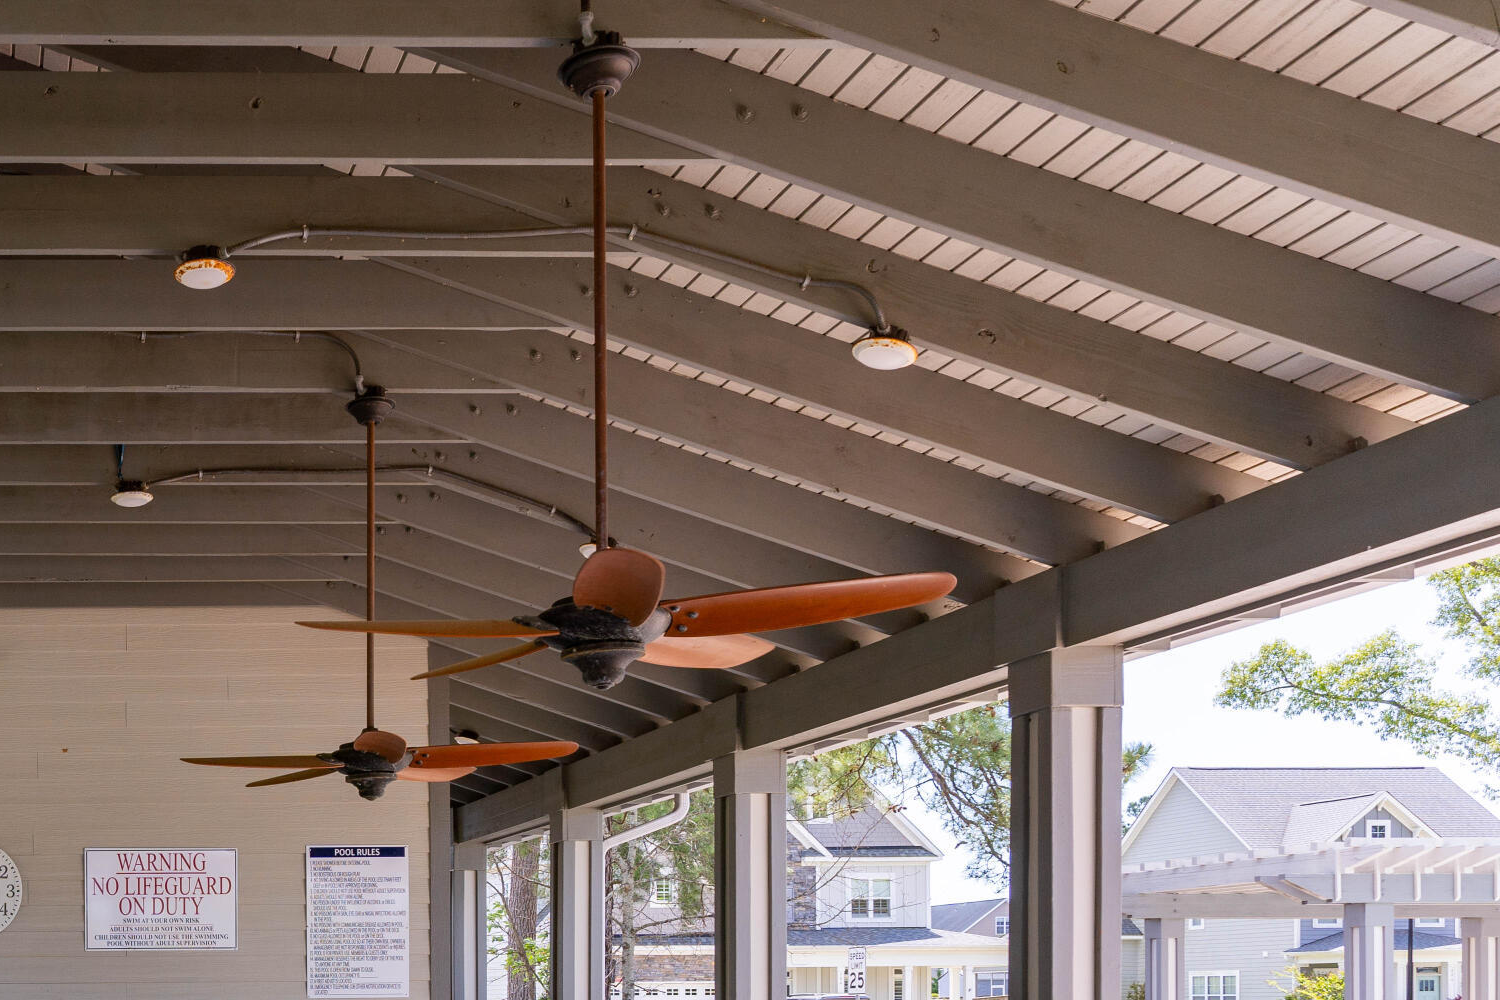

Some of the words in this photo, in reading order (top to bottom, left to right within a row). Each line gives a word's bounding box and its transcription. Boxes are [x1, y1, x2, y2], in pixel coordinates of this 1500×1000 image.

[116, 852, 206, 872] WARNING
[0, 865, 8, 878] 2
[6, 884, 15, 898] 3
[92, 876, 119, 896] NO
[125, 876, 232, 896] LIFEGUARD
[0, 903, 8, 916] 4
[119, 897, 144, 915] ON
[152, 897, 204, 915] DUTY
[850, 972, 864, 988] 25
